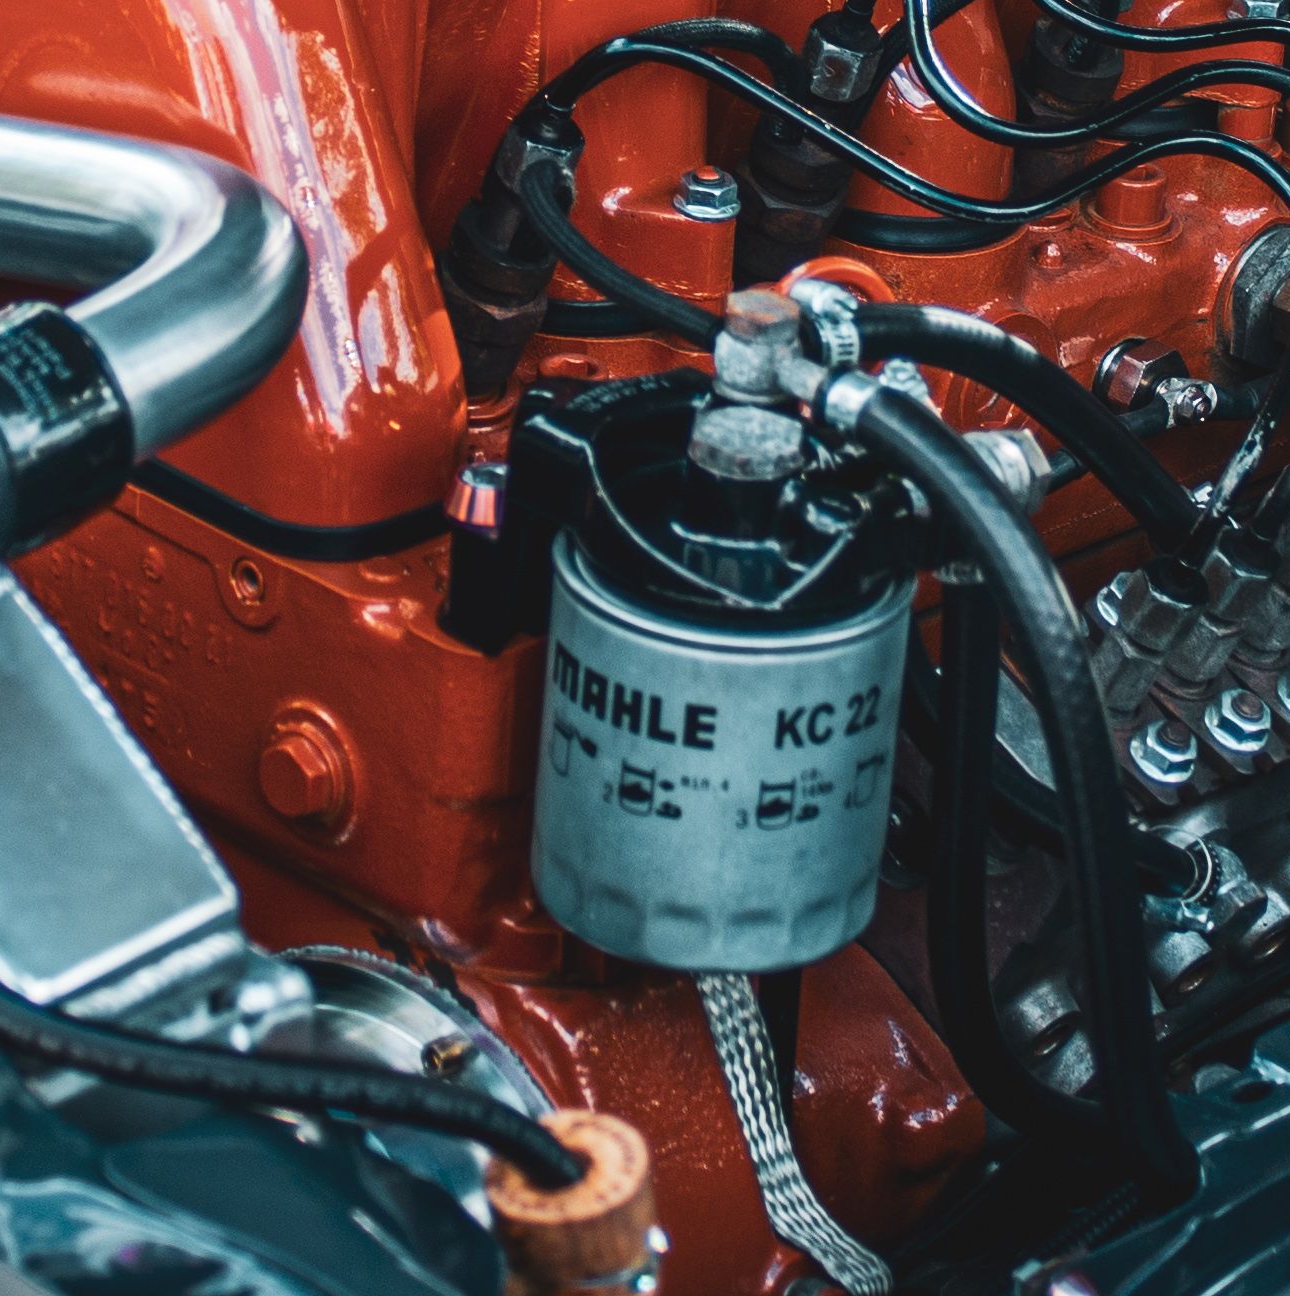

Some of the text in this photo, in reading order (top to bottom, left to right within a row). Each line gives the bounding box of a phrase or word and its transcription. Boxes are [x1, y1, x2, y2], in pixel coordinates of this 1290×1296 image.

[552, 639, 718, 750] MAHLE
[774, 686, 883, 750] KC 22
